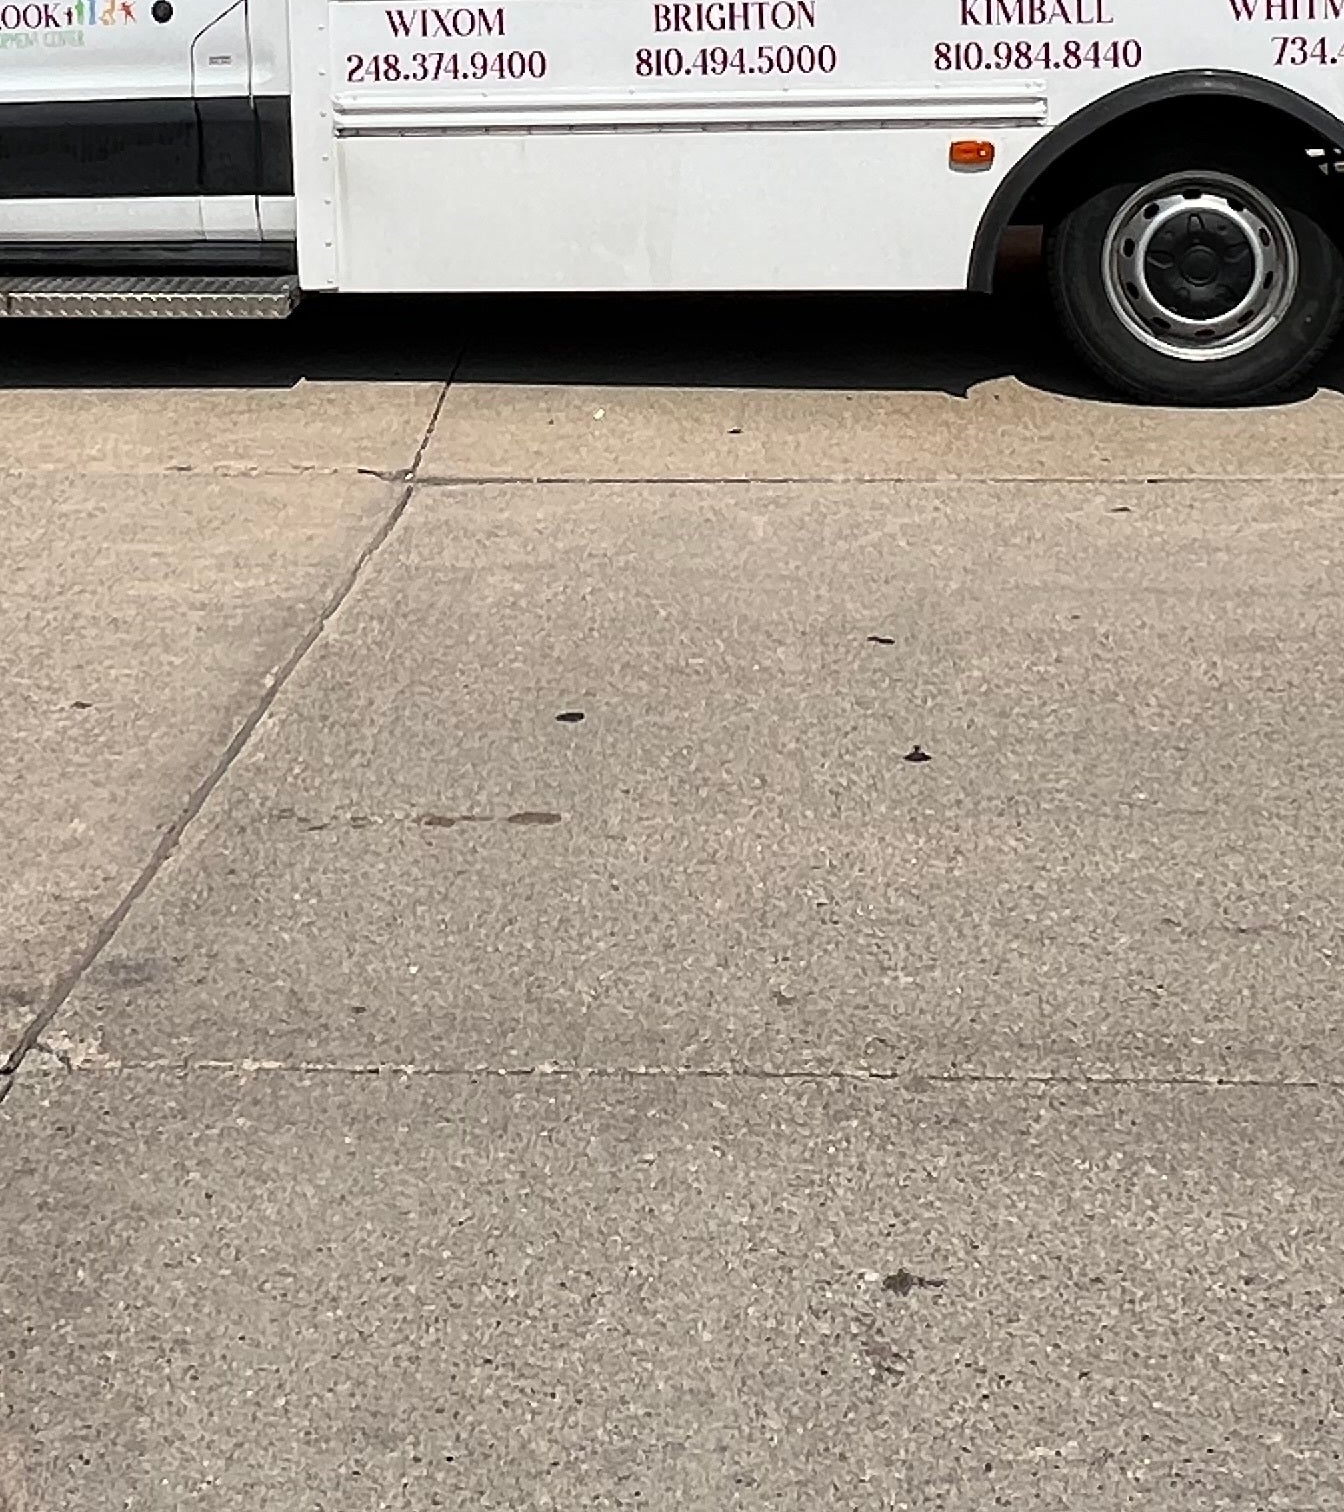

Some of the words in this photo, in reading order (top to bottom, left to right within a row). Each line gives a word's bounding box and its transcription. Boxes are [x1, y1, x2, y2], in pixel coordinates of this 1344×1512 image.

[385, 8, 505, 37] WIXOM
[654, 1, 815, 32] BRIGHTON
[347, 51, 546, 82] 248.374.9400
[636, 45, 836, 76] 810.494.5000
[934, 39, 1141, 71] 810.984.8440
